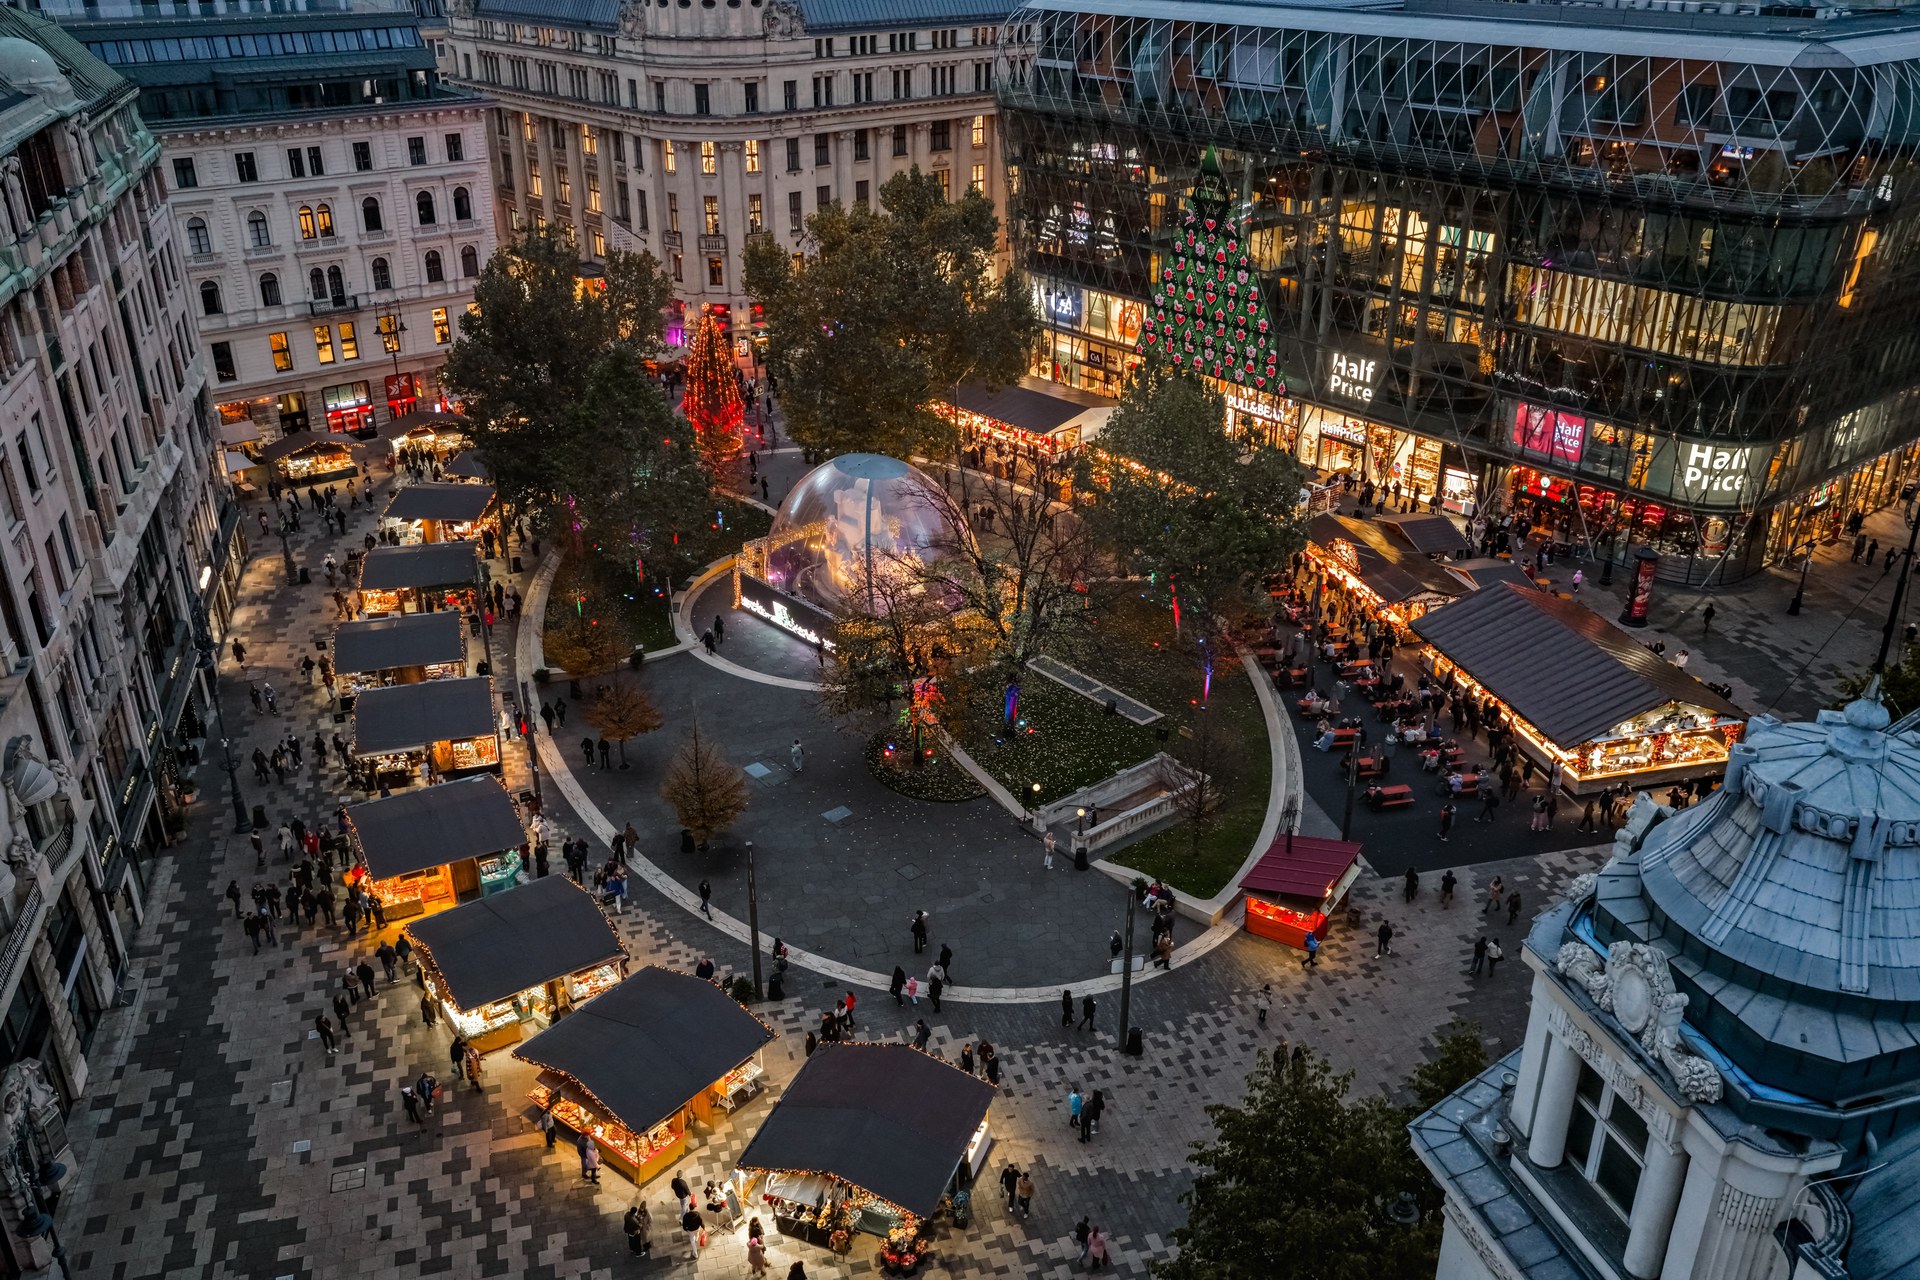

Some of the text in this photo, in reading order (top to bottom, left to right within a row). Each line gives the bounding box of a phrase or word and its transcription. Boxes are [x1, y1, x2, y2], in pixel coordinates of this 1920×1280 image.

[1333, 353, 1375, 383] Half
[1330, 374, 1373, 402] Price
[1227, 395, 1285, 424] PULL&BEAR
[1320, 420, 1365, 443] HalfPrice
[1554, 432, 1579, 448] Price
[1555, 420, 1582, 438] Half
